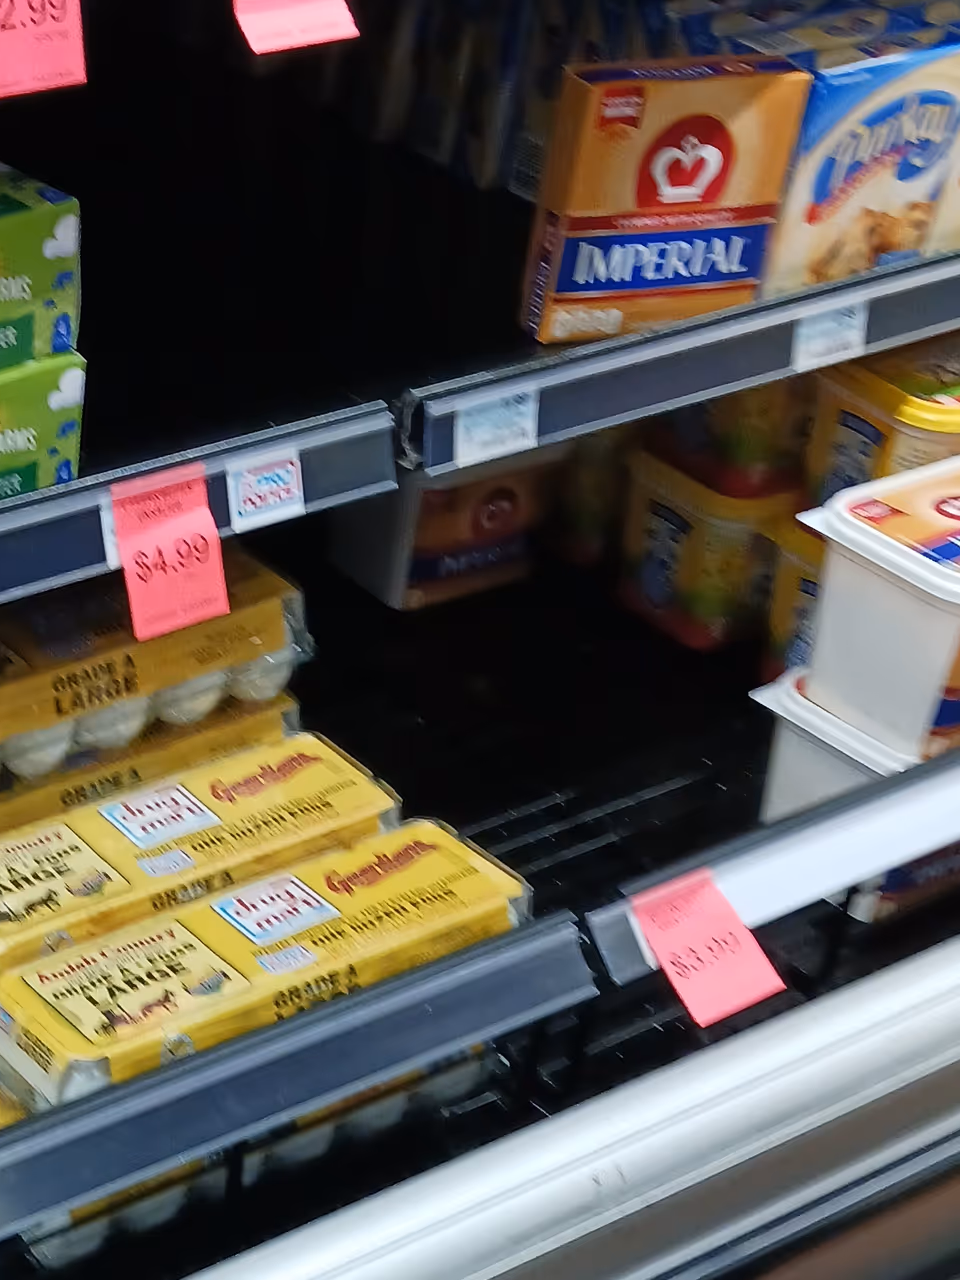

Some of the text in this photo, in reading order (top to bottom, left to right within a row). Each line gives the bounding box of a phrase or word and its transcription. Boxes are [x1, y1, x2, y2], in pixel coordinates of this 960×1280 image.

[572, 236, 752, 284] IMPERIAL
[133, 533, 210, 583] $4.99
[83, 960, 190, 1007] LARGE
